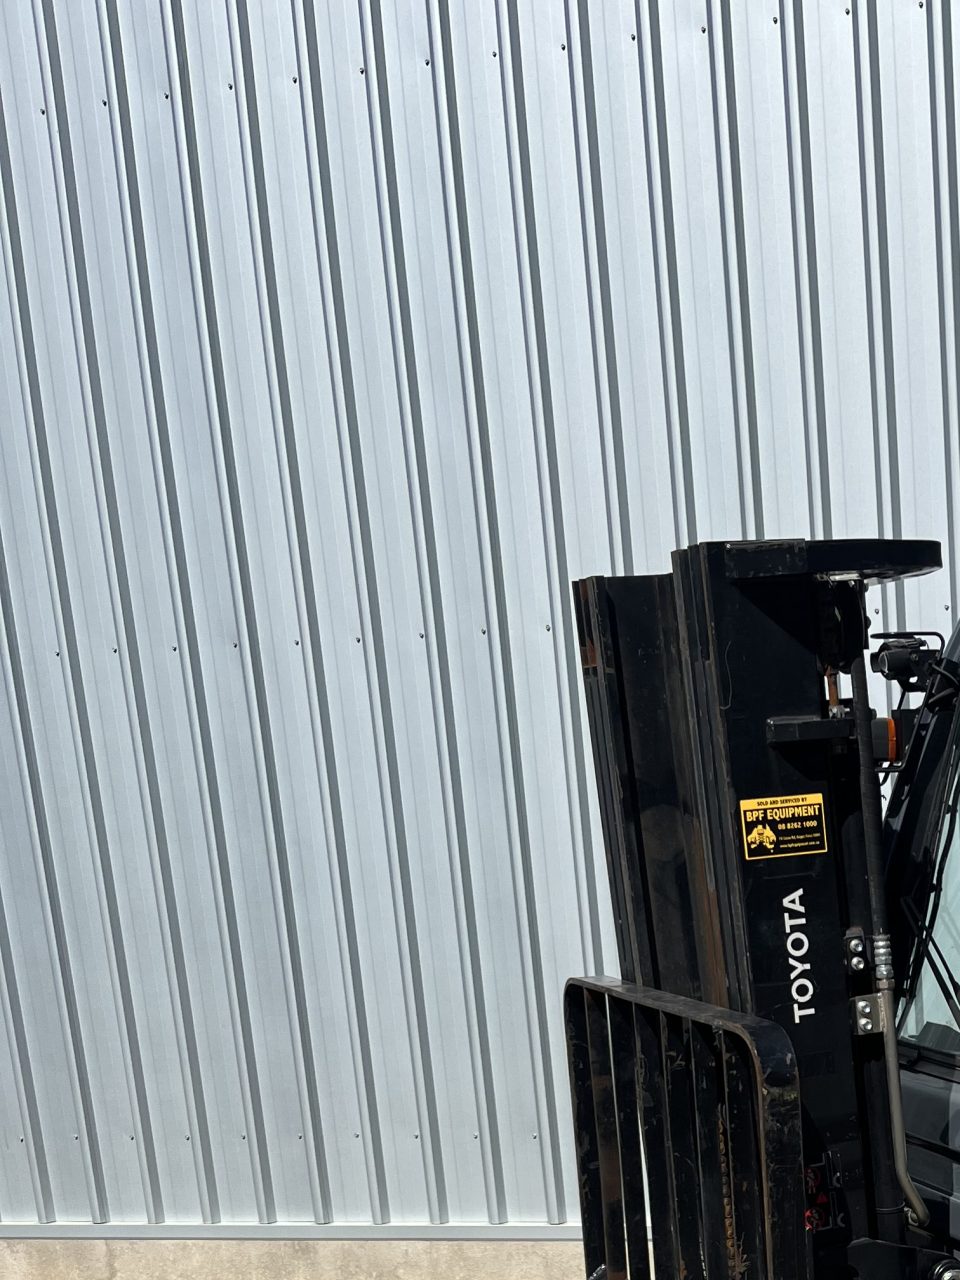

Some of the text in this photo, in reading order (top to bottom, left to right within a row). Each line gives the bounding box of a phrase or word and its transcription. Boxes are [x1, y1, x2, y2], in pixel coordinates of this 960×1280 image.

[746, 805, 820, 822] BPF EQUIPMENT
[782, 887, 816, 1024] TOYOTA
